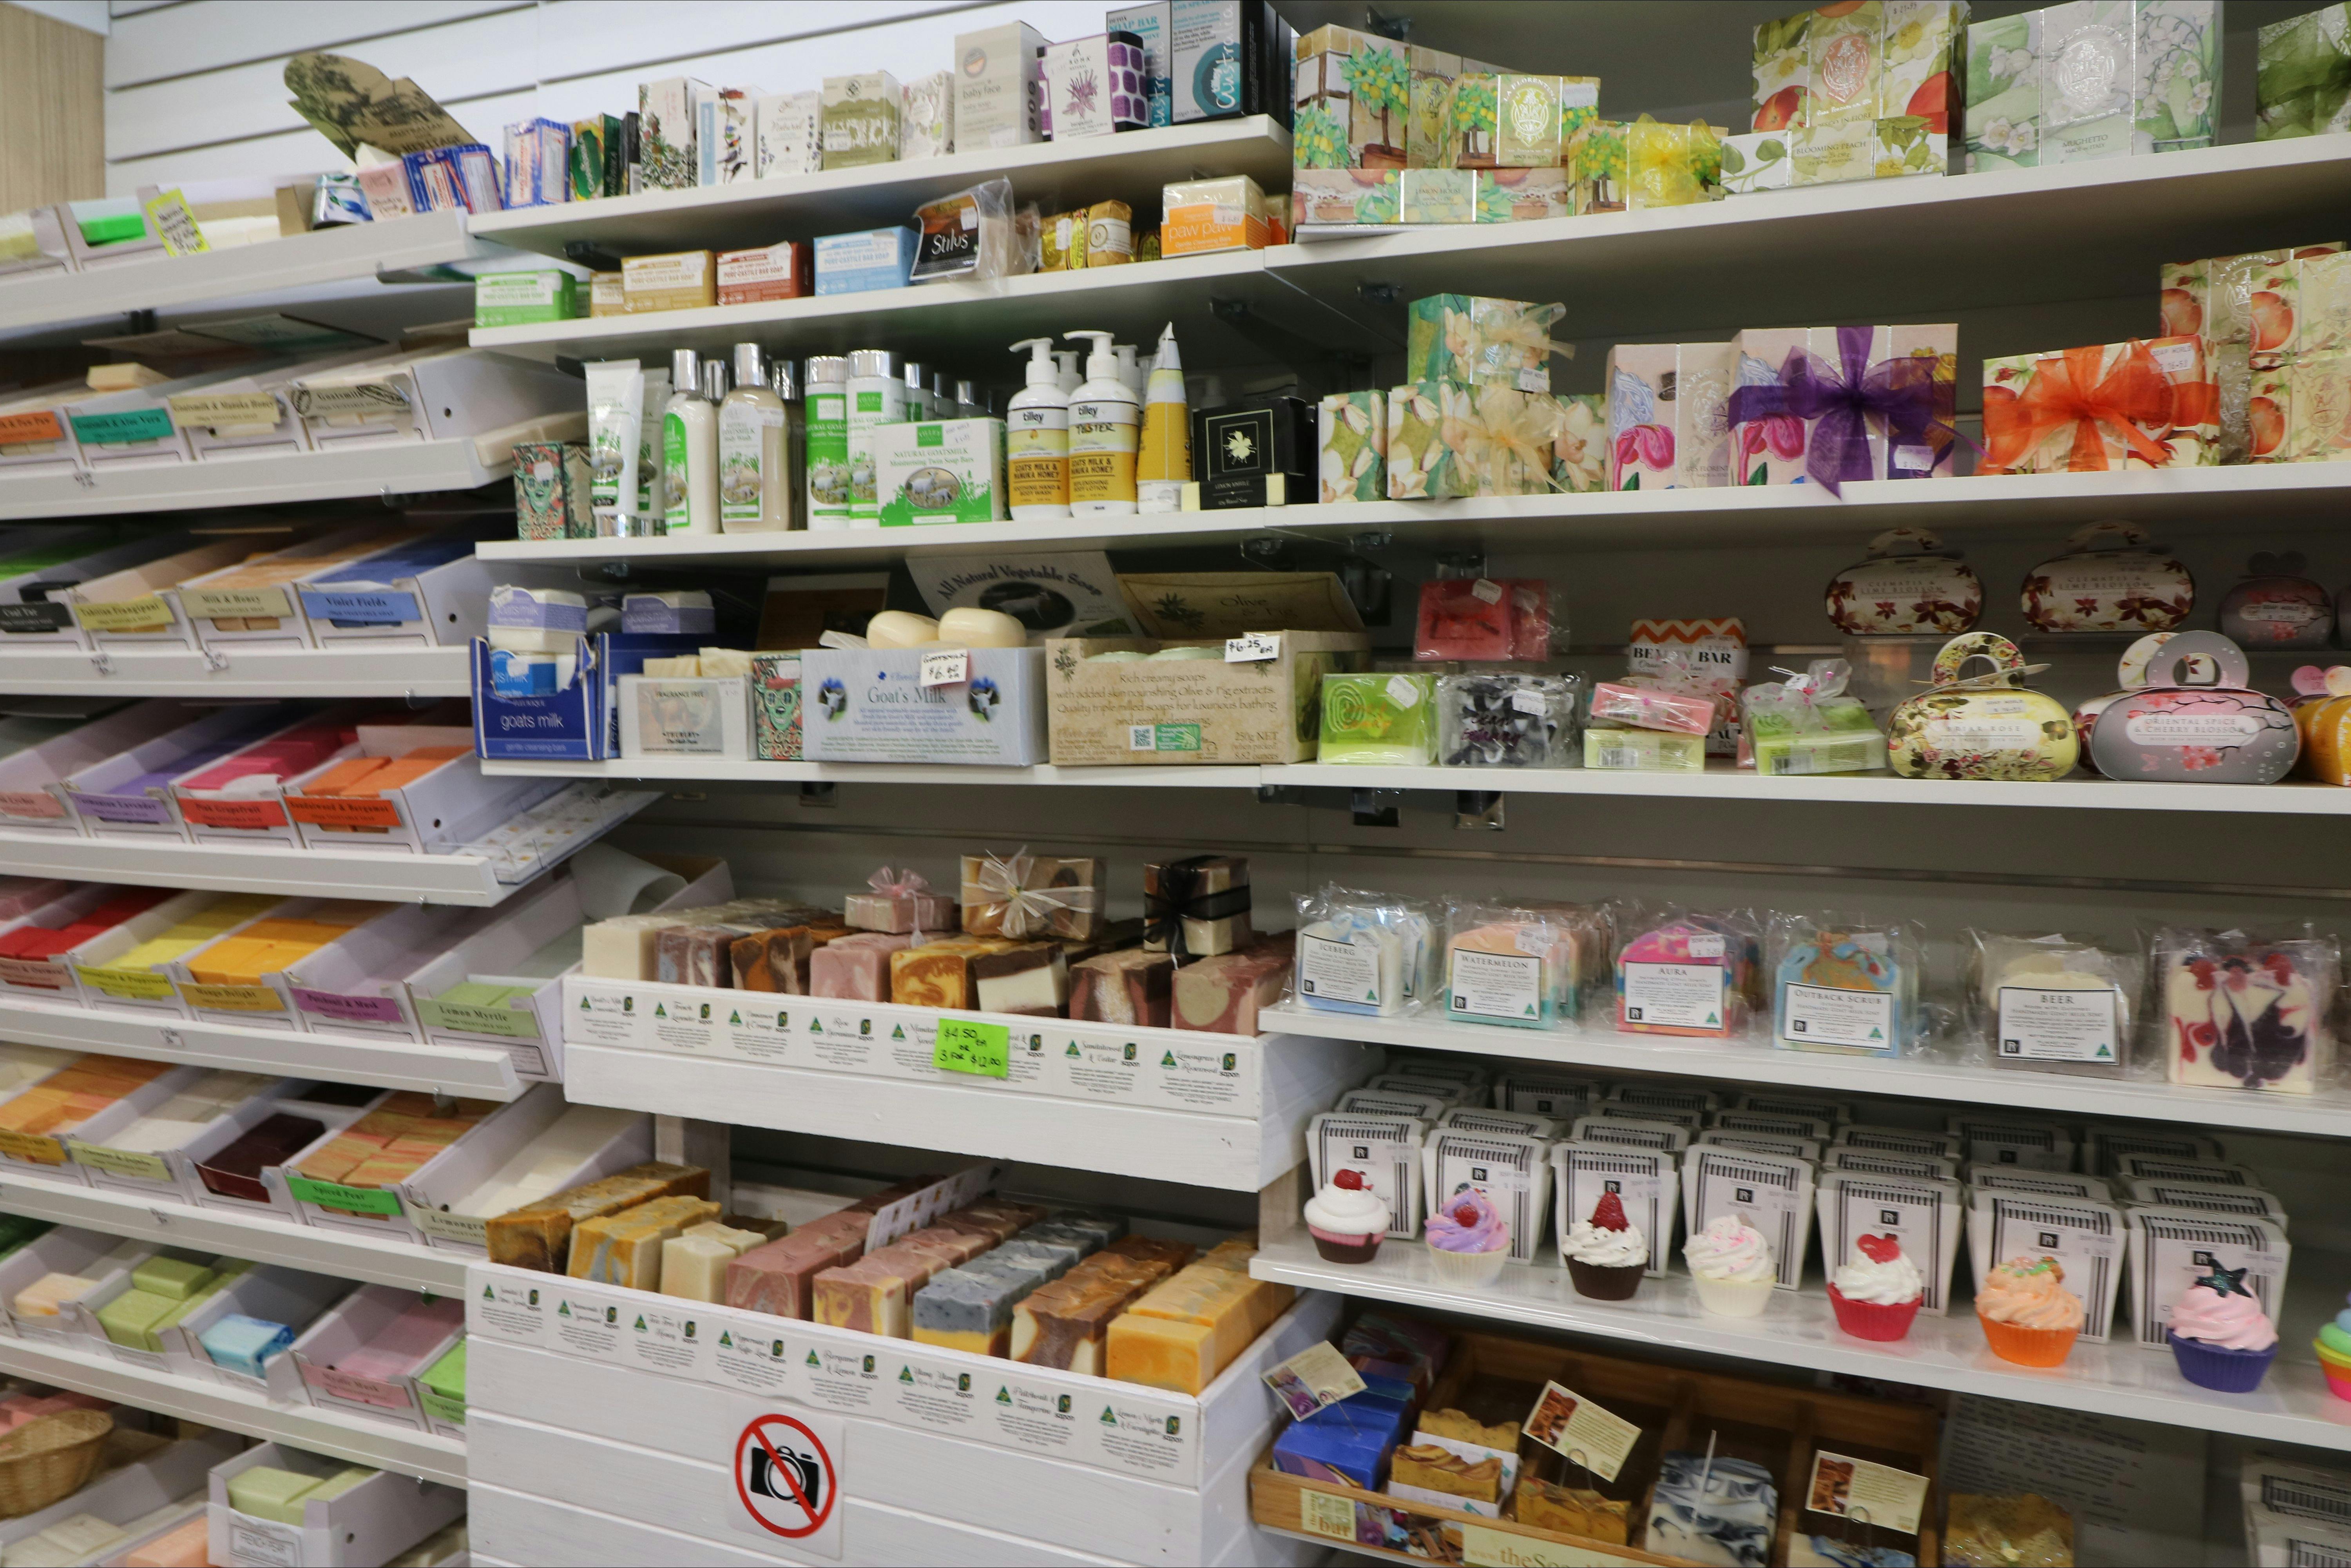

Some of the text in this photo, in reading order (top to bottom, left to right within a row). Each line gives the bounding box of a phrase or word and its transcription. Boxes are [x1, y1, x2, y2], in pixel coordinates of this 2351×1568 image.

[2063, 134, 2108, 147] MUGHETTO
[1796, 145, 1839, 154] BLOOMING
[1078, 405, 1098, 418] tilley
[1023, 411, 1044, 424] tilley
[937, 565, 1102, 600] All Natural Vegetable Soap
[1699, 650, 1732, 665] BAR
[1120, 673, 1206, 686] Rich creamy soaps
[868, 686, 947, 704] Goat's Milk
[1177, 686, 1203, 696] Olive
[500, 712, 565, 731] goats milk
[1115, 717, 1134, 726] and
[2145, 717, 2202, 726] ORIENTAL
[1319, 943, 1355, 956] ICEBERG
[1460, 954, 1529, 969] WATERMELON
[1659, 967, 1688, 976] AURA
[1794, 989, 1845, 1001] OUTBACK
[2040, 994, 2075, 1004] BEER
[438, 1004, 471, 1017] Lemon
[1027, 1050, 1046, 1059] sapon
[1120, 1059, 1141, 1068] sapon
[1219, 1070, 1241, 1079] sapon
[682, 1336, 699, 1345] sapon
[769, 1355, 786, 1365] sapon
[860, 1372, 879, 1381] sapon
[955, 1390, 975, 1400] sapon
[1054, 1412, 1076, 1422] sapon
[1162, 1433, 1184, 1444] sapon
